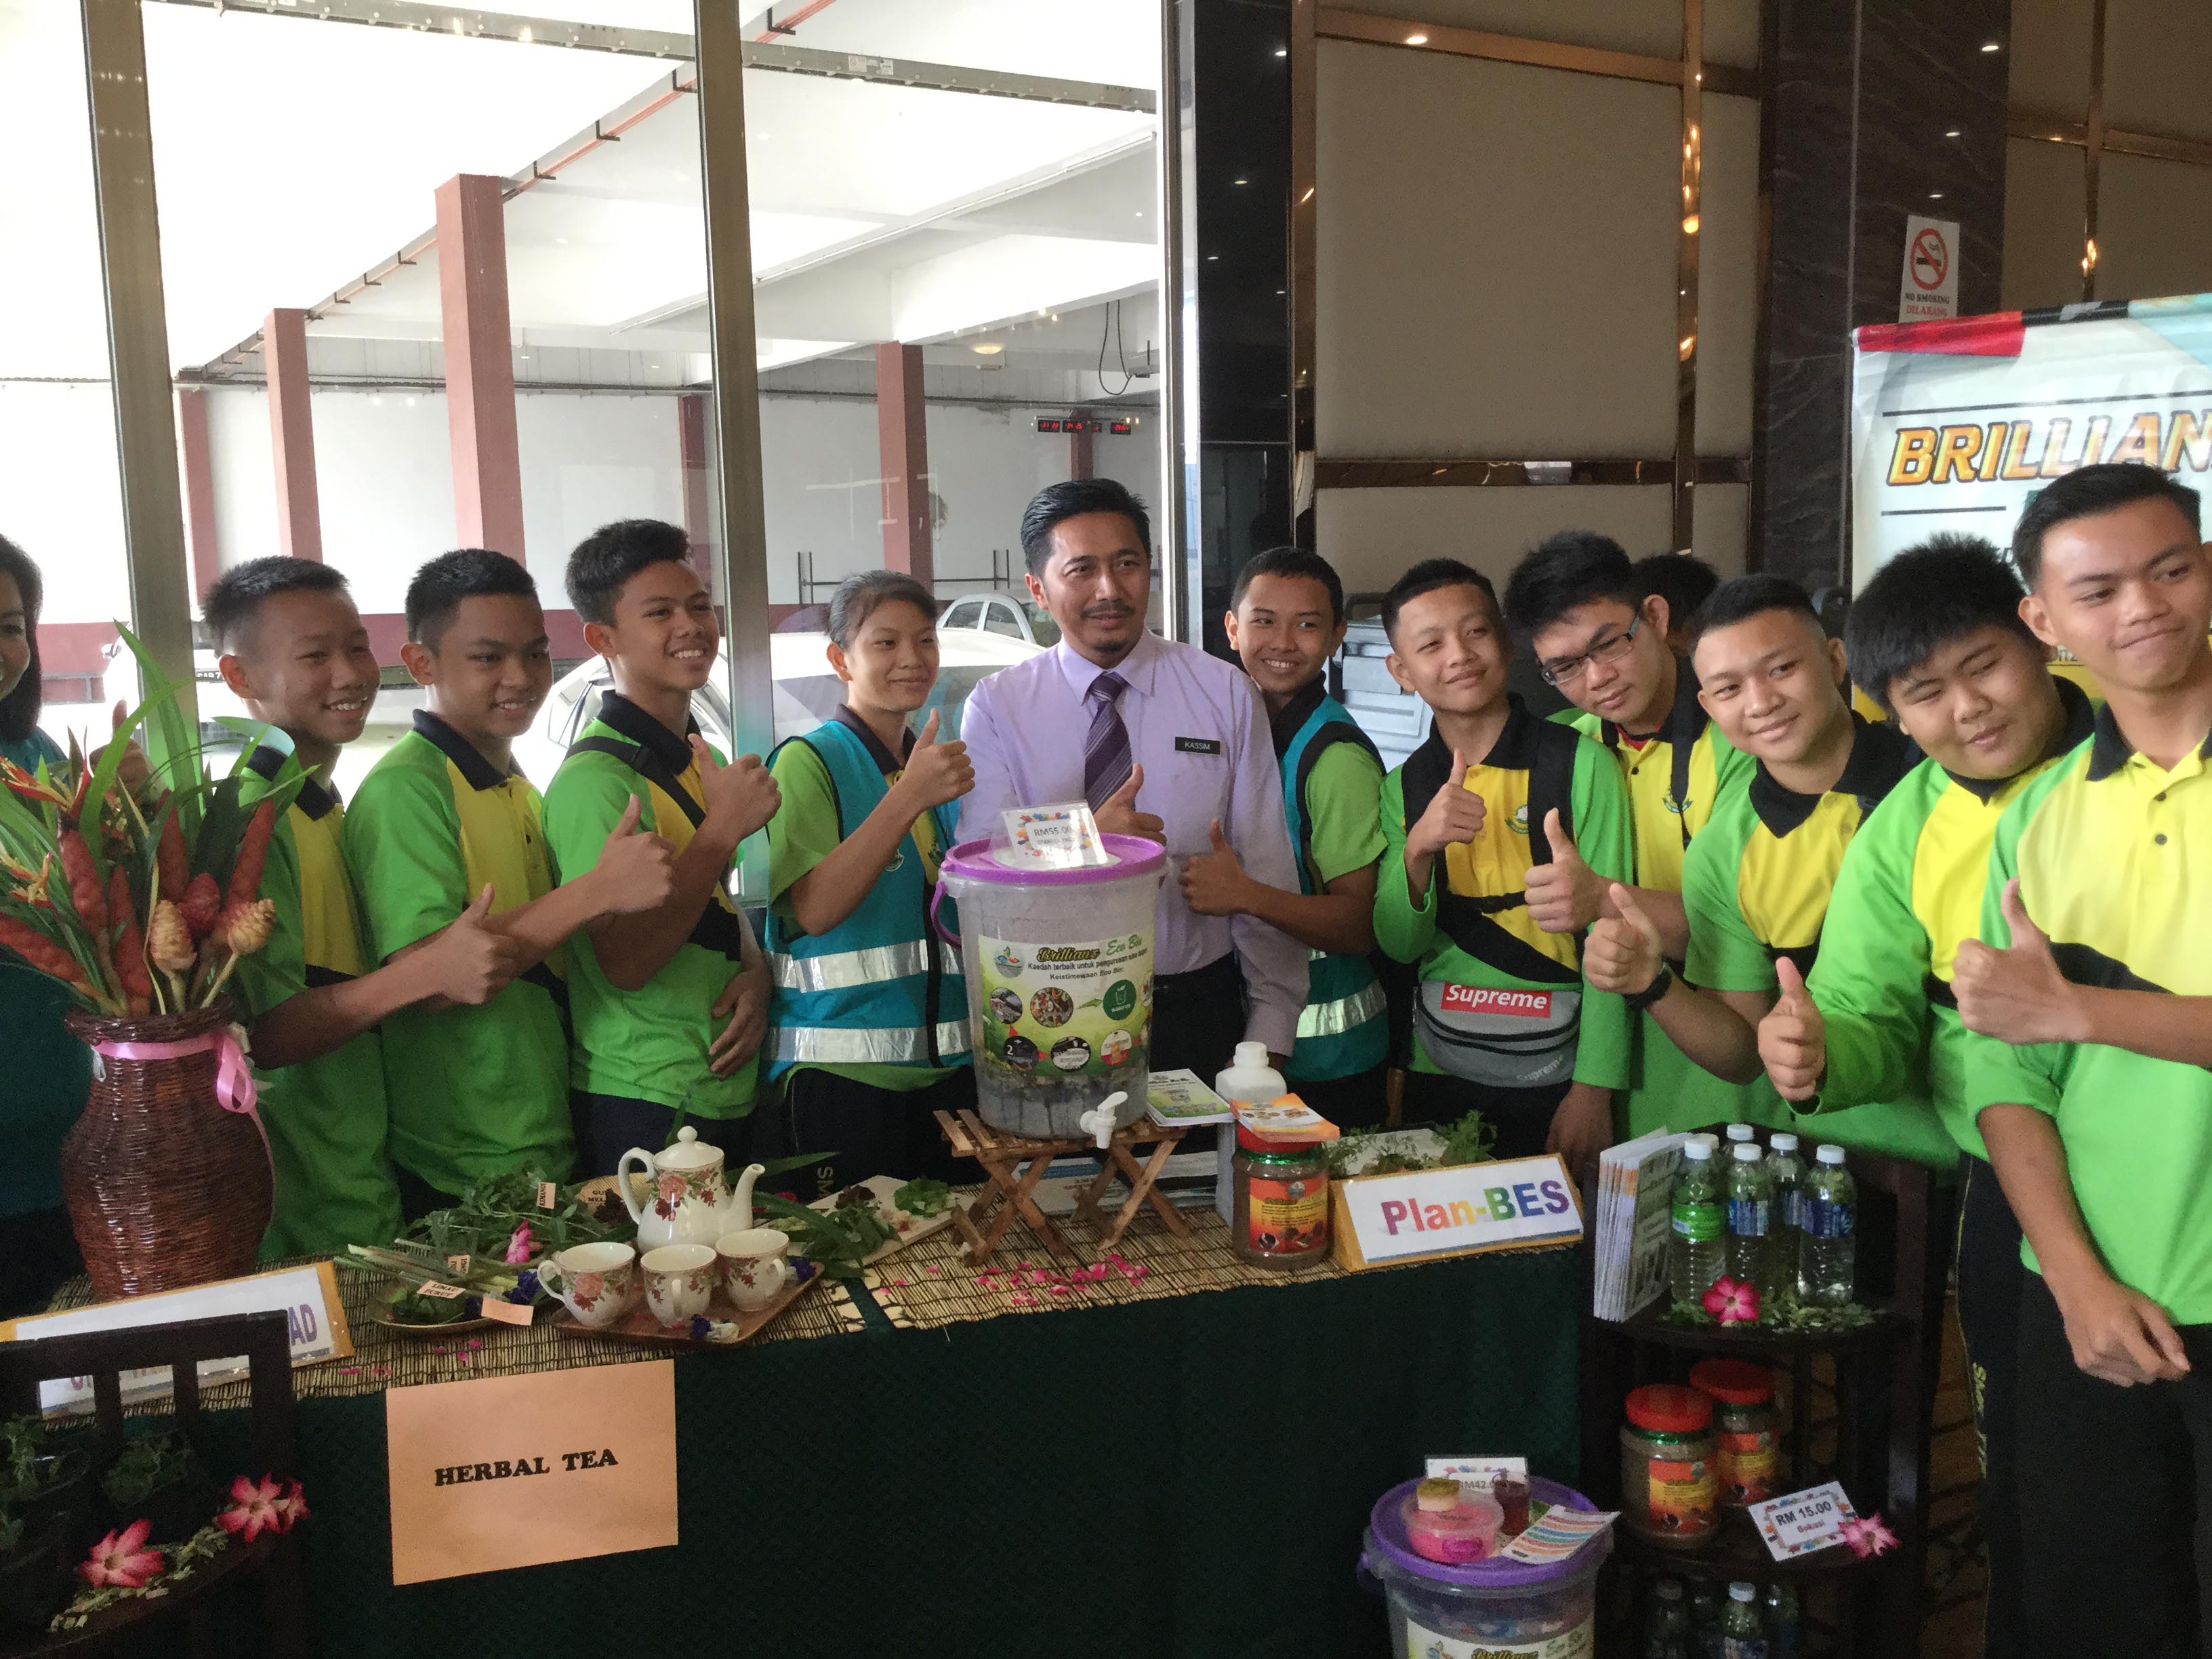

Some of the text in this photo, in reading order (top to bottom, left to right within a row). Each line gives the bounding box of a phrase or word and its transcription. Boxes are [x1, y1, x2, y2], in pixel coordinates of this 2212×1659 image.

[1905, 292, 1950, 304] NO SMOKING
[1886, 409, 2212, 487] BRILLIAN
[1185, 741, 1210, 750] KASSIM
[1446, 985, 1547, 1010] Supreme
[1380, 1180, 1570, 1235] Plan-BES
[434, 1448, 619, 1487] HERBAL TEA
[1776, 1500, 1832, 1525] RM 15.00
